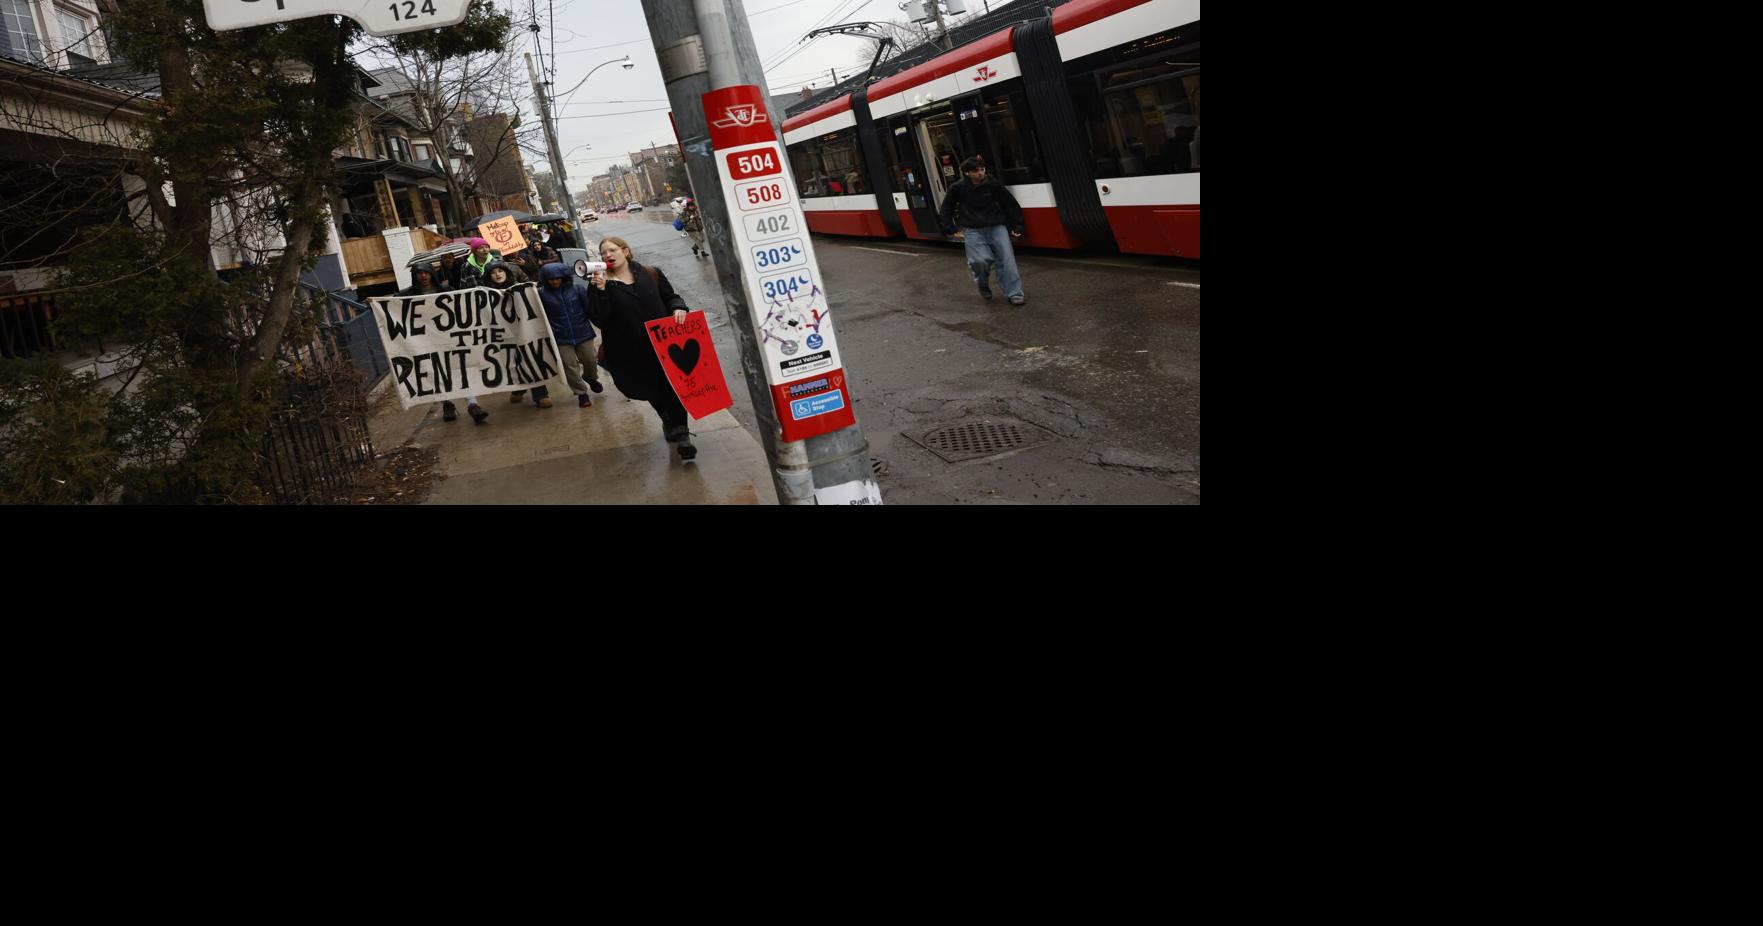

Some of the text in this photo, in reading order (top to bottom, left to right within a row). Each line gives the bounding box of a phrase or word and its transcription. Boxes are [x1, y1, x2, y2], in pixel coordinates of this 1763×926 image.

[388, 0, 437, 21] 124
[738, 153, 774, 174] 504
[747, 184, 782, 204] 508
[756, 214, 790, 234] 402
[756, 246, 792, 267] 303
[764, 276, 799, 298] 304
[378, 298, 426, 341] WE
[450, 328, 505, 347] THE
[788, 359, 803, 367] Next
[803, 353, 824, 363] Vehicle
[391, 349, 471, 398] RENT
